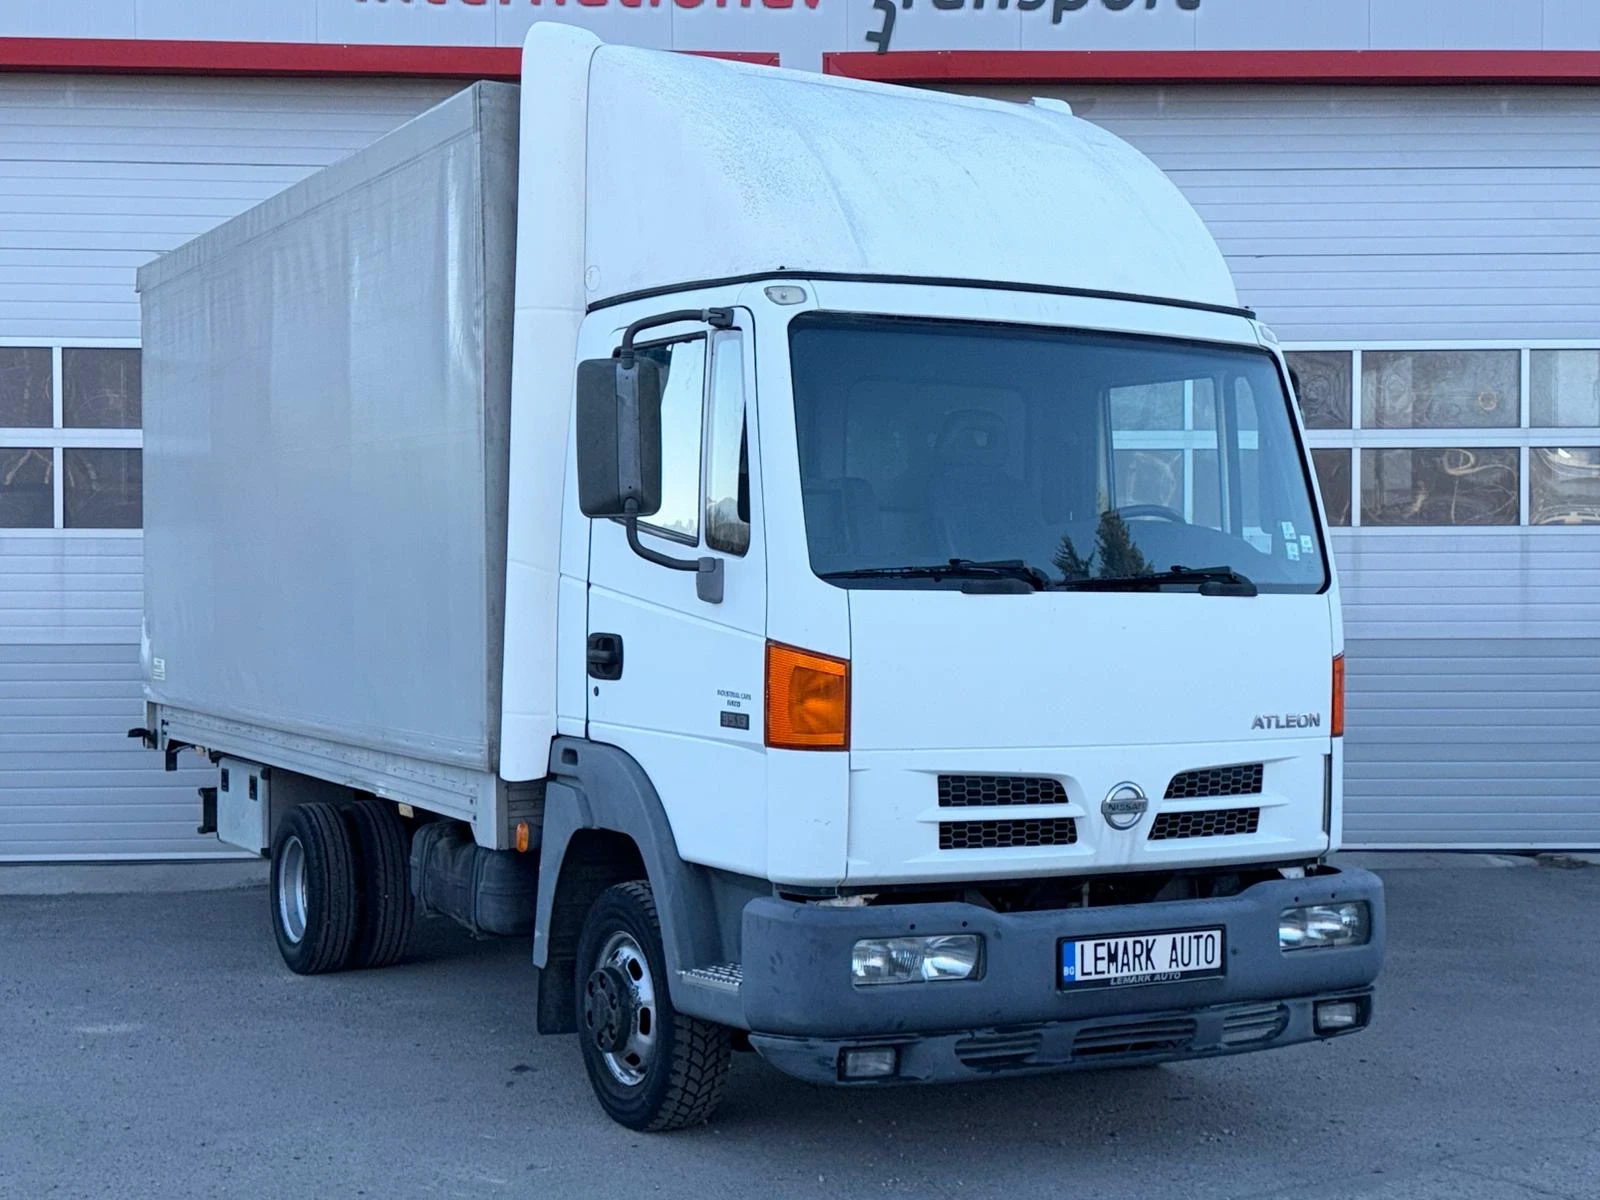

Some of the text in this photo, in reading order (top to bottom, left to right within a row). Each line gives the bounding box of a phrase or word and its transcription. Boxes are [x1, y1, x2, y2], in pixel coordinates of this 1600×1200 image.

[1251, 713, 1320, 729] ATLEON
[1108, 802, 1145, 811] NISSAN
[1063, 934, 1215, 976] BG LEMARK AUTO
[1110, 972, 1181, 985] LEMARK AUTO
